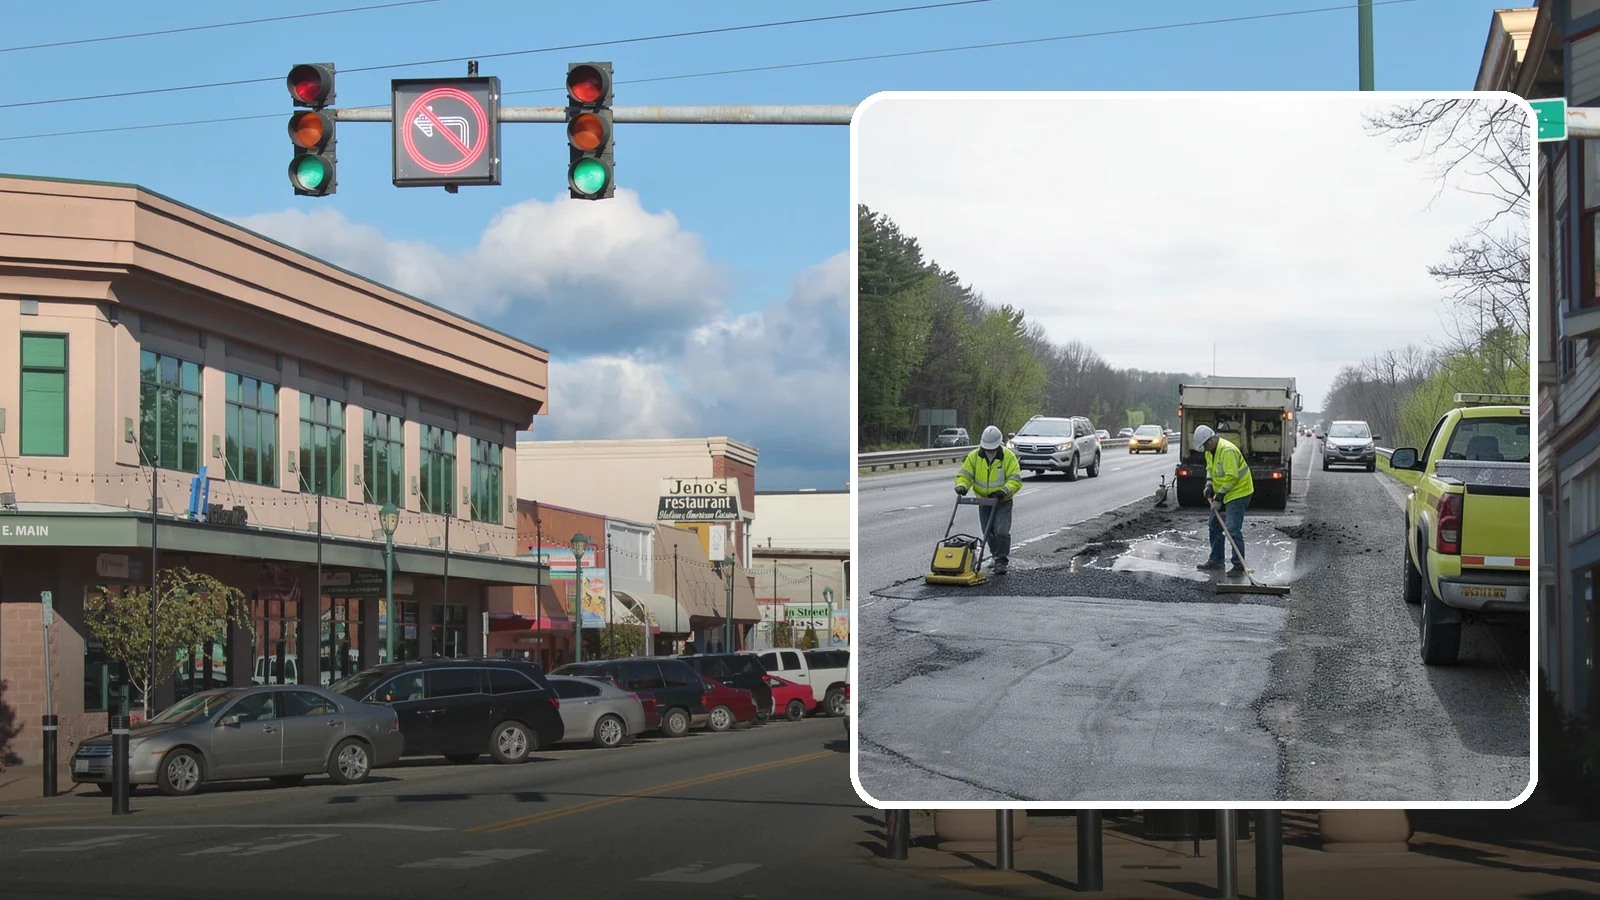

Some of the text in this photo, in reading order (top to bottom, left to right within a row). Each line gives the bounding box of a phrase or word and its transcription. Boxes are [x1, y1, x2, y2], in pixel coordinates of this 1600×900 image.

[670, 480, 727, 494] Jeno's
[665, 496, 731, 508] restaurant
[658, 510, 681, 519] Italian
[686, 510, 714, 519] American
[715, 509, 737, 519] Cuisine
[2, 525, 49, 536] E. MAIN
[797, 608, 828, 616] Street
